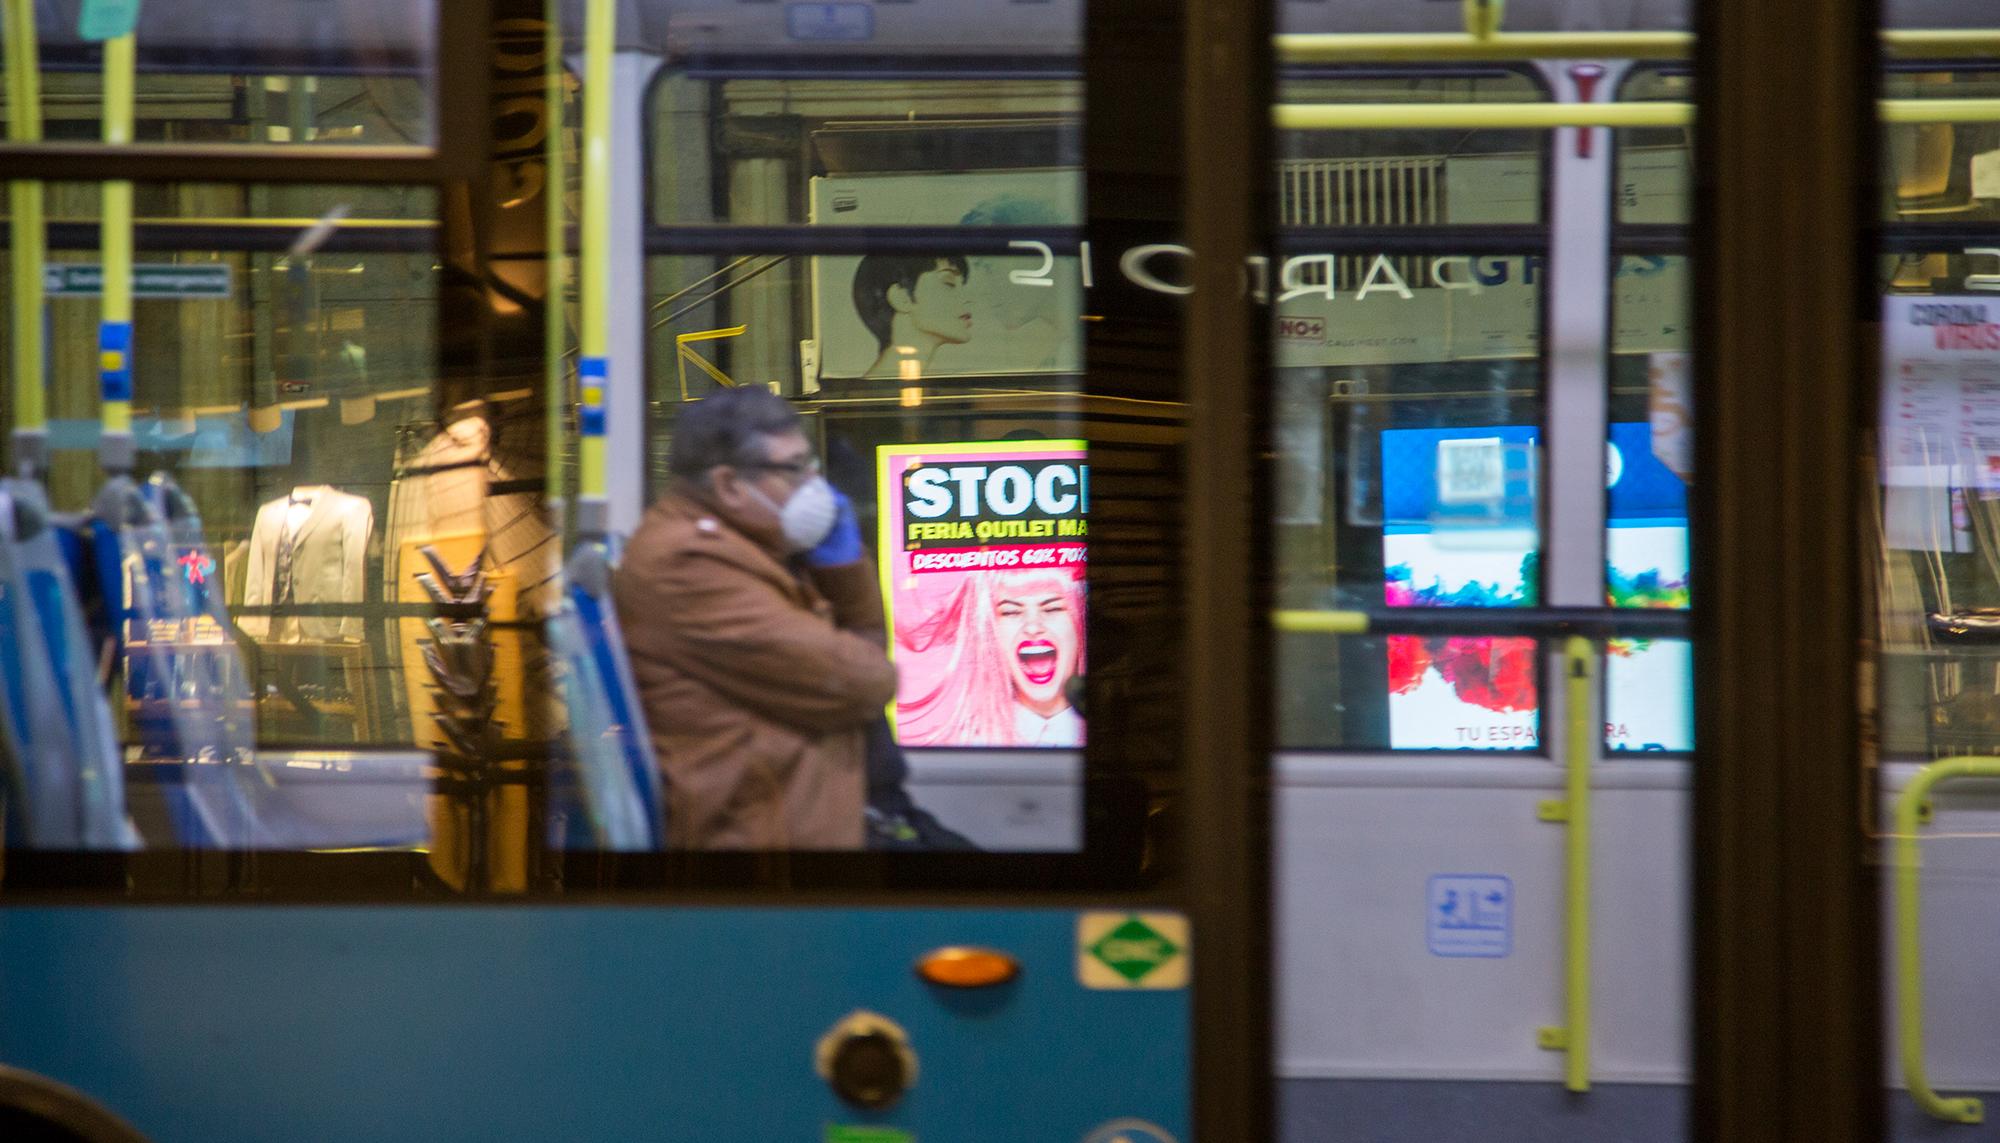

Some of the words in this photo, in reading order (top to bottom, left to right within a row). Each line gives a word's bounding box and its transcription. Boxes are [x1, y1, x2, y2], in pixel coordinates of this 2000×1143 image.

[908, 522, 974, 540] FERIA
[975, 519, 1056, 539] OUTLET
[912, 550, 1020, 570] DESCUENTOS
[1455, 726, 1480, 741] TU
[1489, 726, 1541, 741] ESPA
